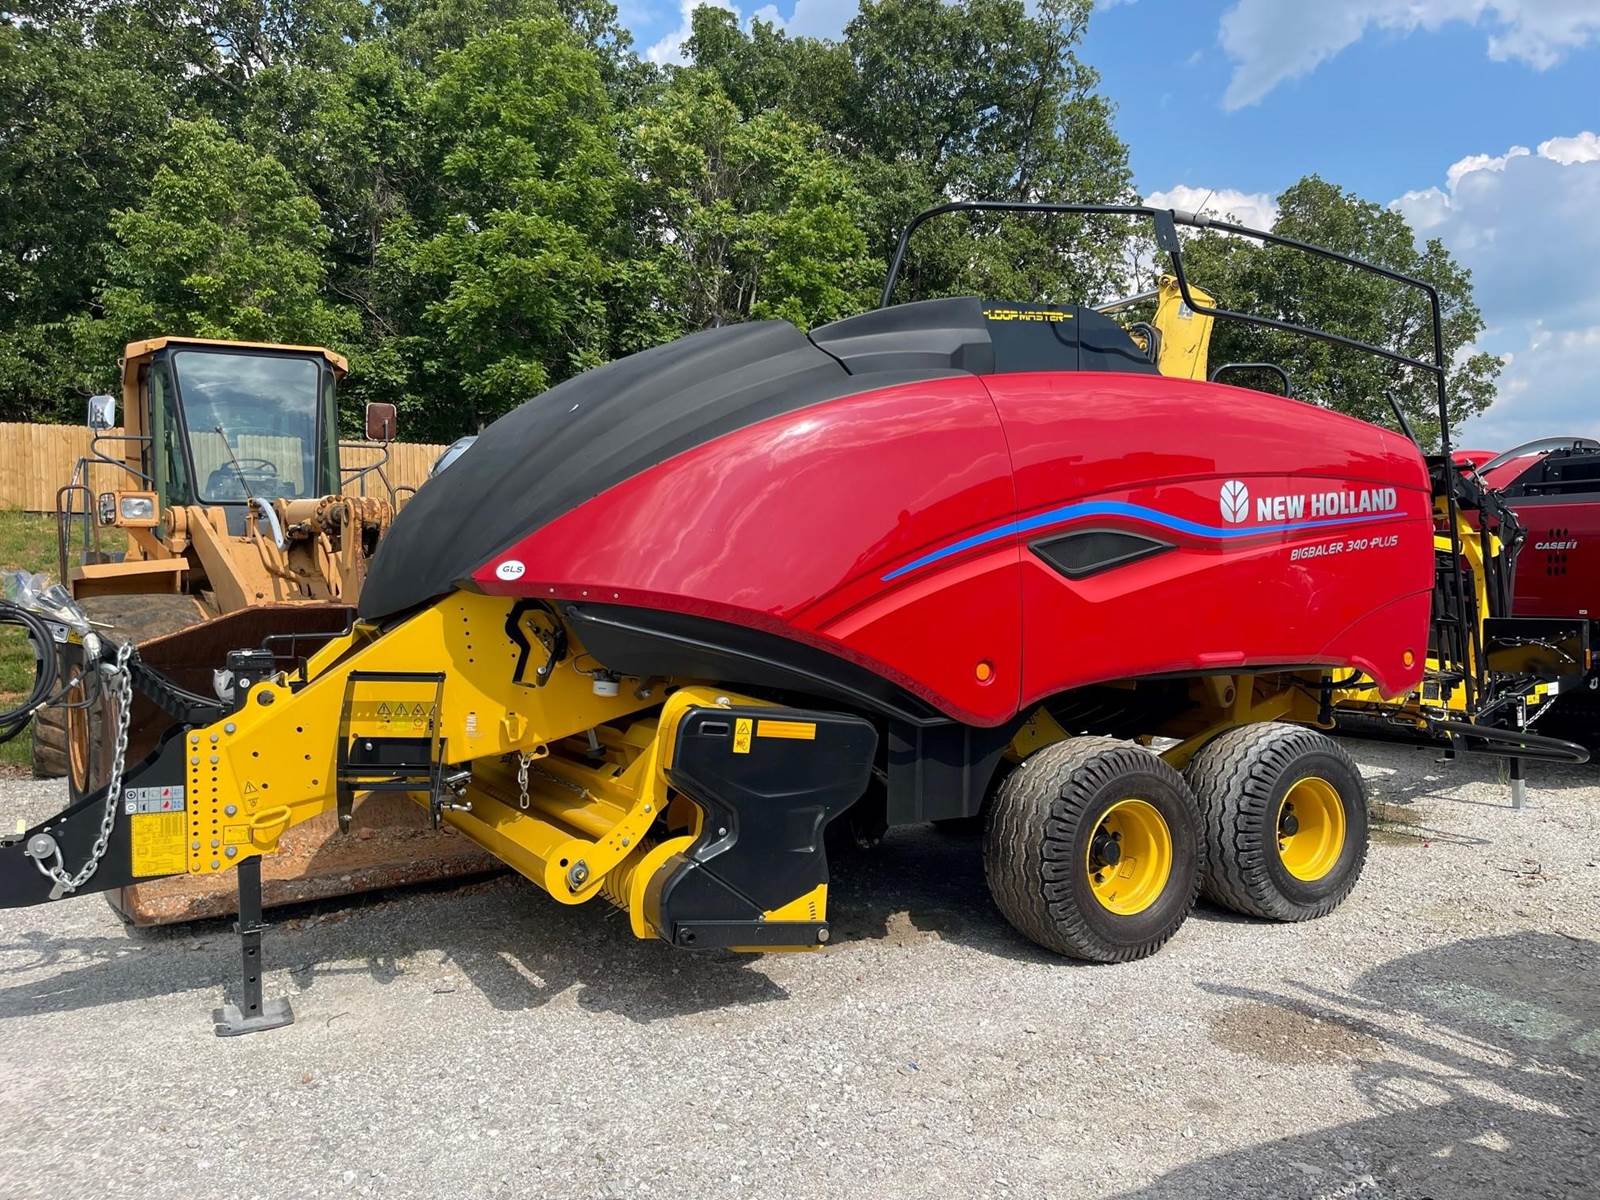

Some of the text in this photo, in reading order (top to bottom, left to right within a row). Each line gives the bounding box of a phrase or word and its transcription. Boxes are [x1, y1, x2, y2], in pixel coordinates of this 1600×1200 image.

[1257, 488, 1397, 521] NEW HOLLAND
[1290, 542, 1344, 561] BIGBALER
[1346, 539, 1368, 552] 340
[502, 565, 523, 573] GLS
